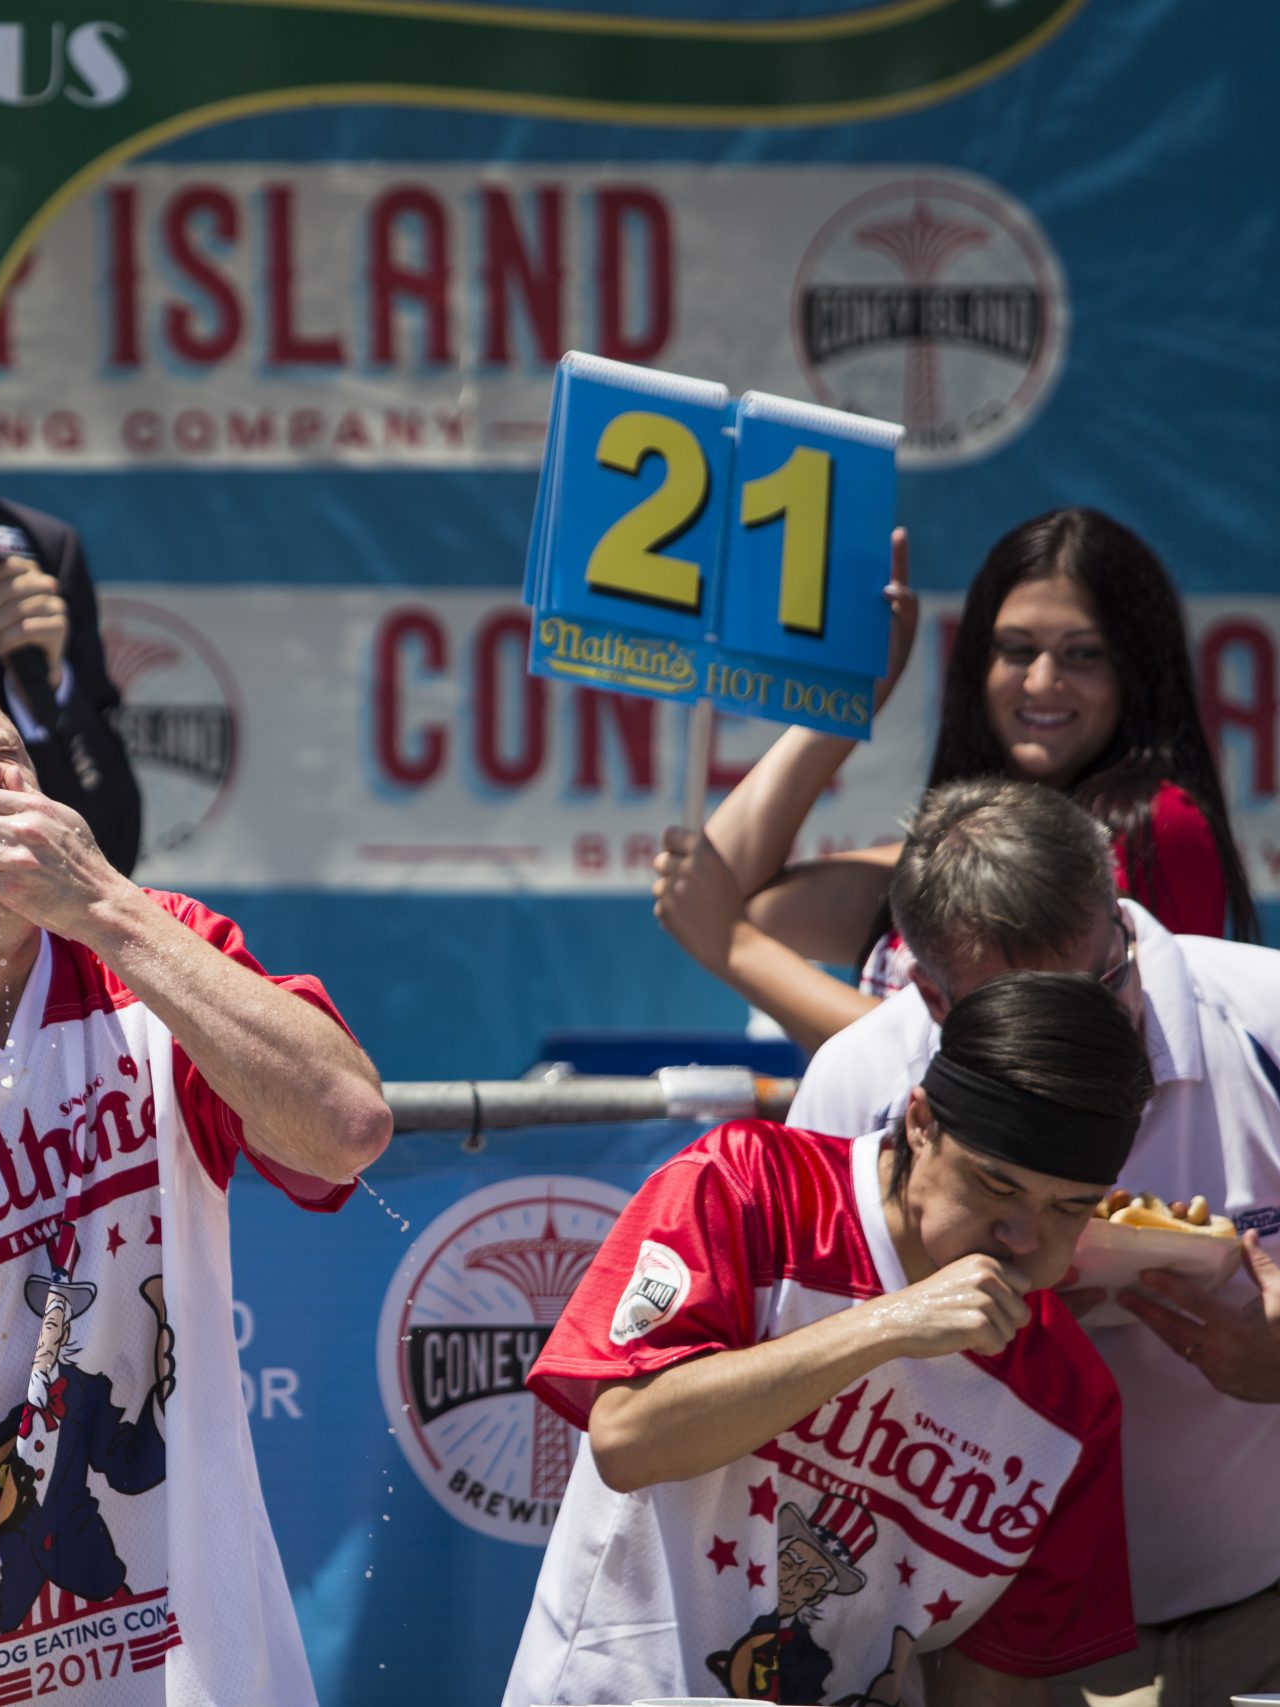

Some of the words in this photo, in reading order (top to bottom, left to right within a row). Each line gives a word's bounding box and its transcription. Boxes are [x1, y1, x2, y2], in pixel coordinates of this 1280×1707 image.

[108, 181, 674, 367] ISLAND
[119, 408, 470, 454] COMPANY
[584, 410, 835, 641] 21
[539, 616, 693, 671] Nathan's
[707, 663, 775, 705] HOT
[782, 678, 869, 726] DOGS
[637, 1279, 673, 1309] LAND
[423, 1330, 540, 1408] CONEY
[913, 1412, 959, 1448] SINCE
[786, 1378, 1049, 1555] than's
[447, 1467, 559, 1527] BREWI
[35, 1617, 117, 1658] EATING
[123, 1603, 169, 1632] CON
[35, 1641, 125, 1696] 2017
